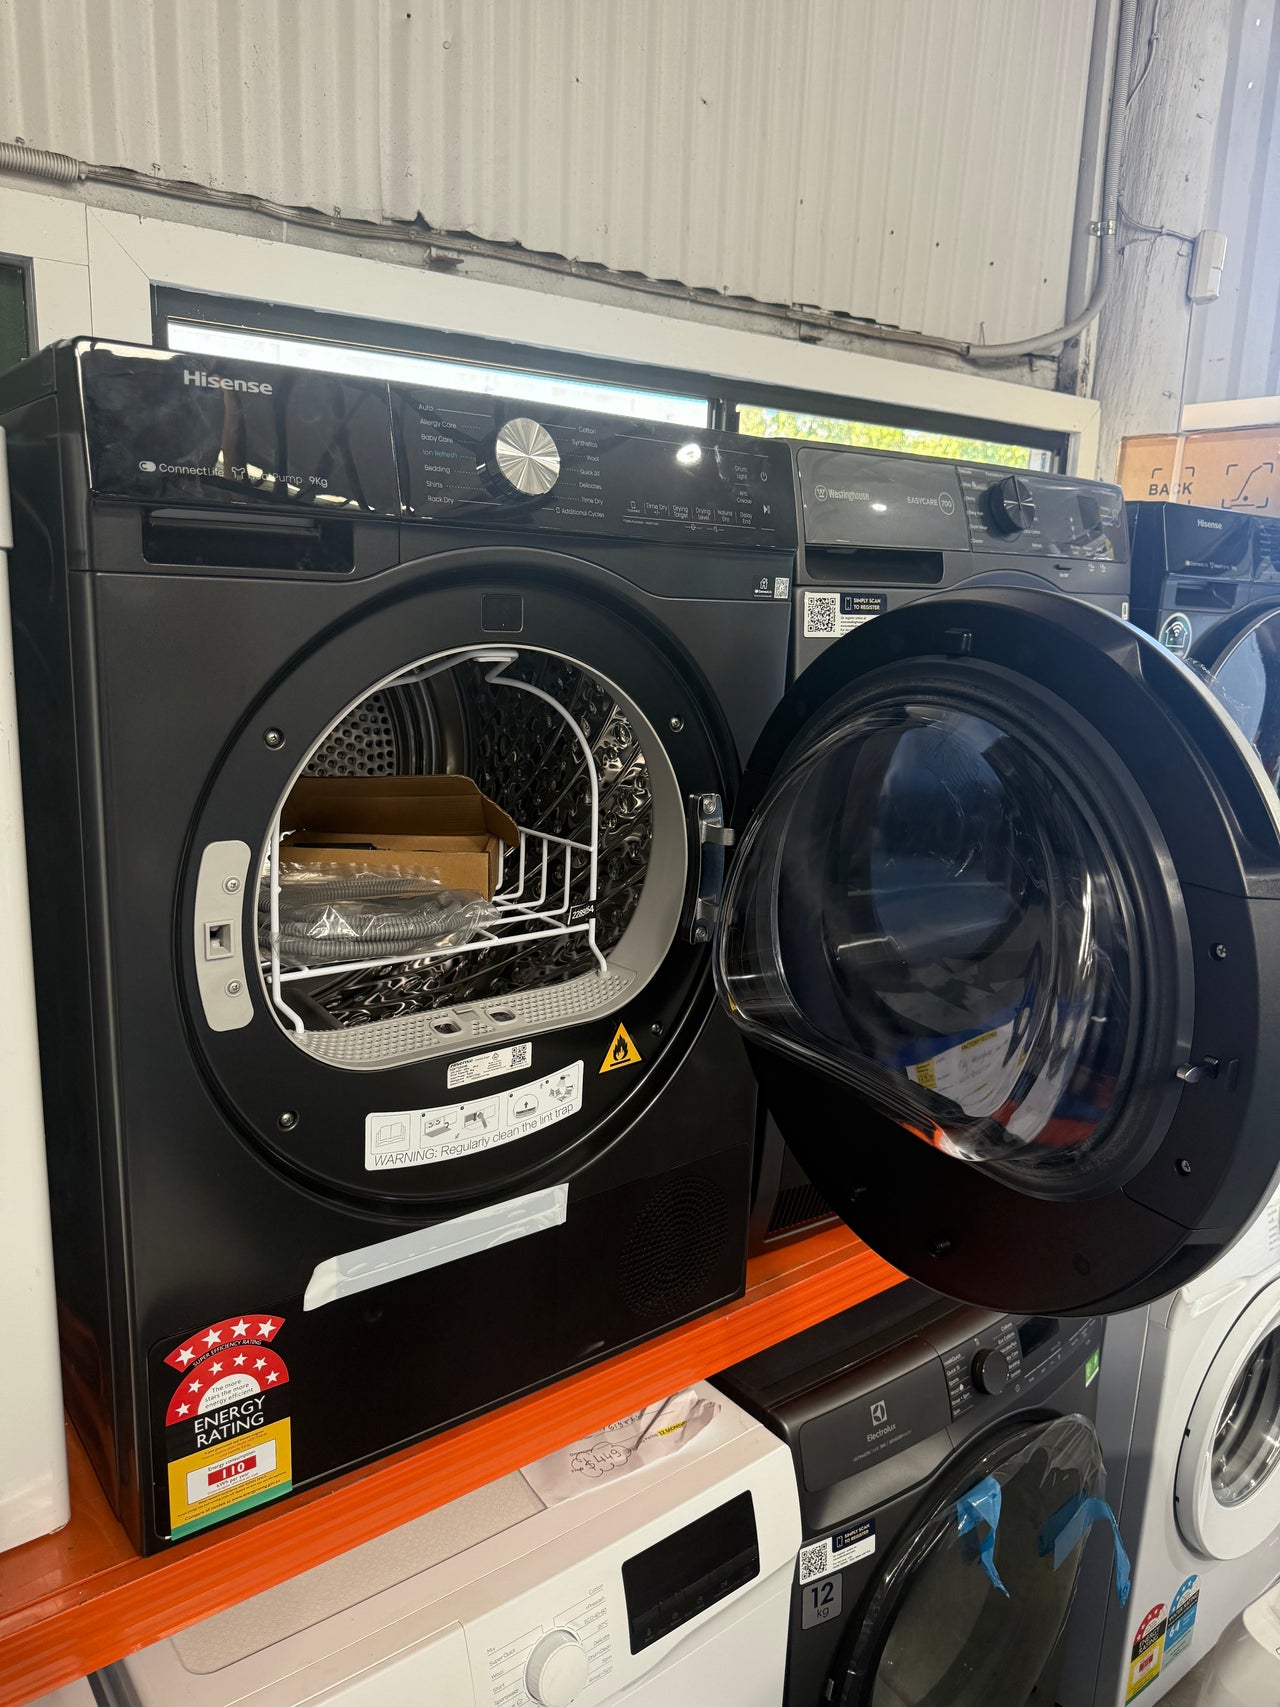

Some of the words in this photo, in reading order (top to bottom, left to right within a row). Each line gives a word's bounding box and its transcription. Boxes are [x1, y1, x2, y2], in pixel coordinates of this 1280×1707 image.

[183, 369, 273, 395] Hisense
[418, 403, 434, 412] Auto
[420, 418, 441, 429] Allergy
[441, 421, 457, 429] Care
[578, 425, 597, 435] Cotton
[421, 433, 438, 443] Baby
[438, 435, 454, 444] Care
[571, 438, 598, 449] Synthetics
[434, 449, 458, 459] Refresh
[158, 463, 225, 478] ConnectLife
[424, 464, 451, 475] Bedding
[308, 476, 328, 488] 9Kg
[425, 480, 443, 489] Shirts
[578, 481, 602, 490] Delicates
[827, 488, 870, 501] Westinghouse
[1148, 481, 1194, 496] BACK
[427, 495, 442, 503] Rack
[443, 496, 454, 505] Dry
[907, 496, 938, 507] EASYCARE
[645, 502, 660, 511] Time
[672, 504, 689, 513] Drying
[695, 507, 712, 516] Drying
[1197, 519, 1223, 530] Hisense
[373, 1148, 438, 1167] WARNING:
[440, 1137, 490, 1157] Regularly
[492, 1126, 520, 1143] clean
[521, 1118, 538, 1133] the
[539, 1112, 553, 1126] lint
[554, 1103, 574, 1121] trap
[192, 1352, 211, 1367] SUPER
[210, 1340, 242, 1355] EFFICIENCY
[204, 1393, 220, 1403] stars
[221, 1387, 232, 1397] the
[233, 1382, 250, 1392] more
[211, 1382, 224, 1394] The
[224, 1379, 242, 1389] more
[205, 1398, 227, 1410] energy
[228, 1387, 254, 1401] efficient
[194, 1395, 266, 1433] ENERGY
[197, 1412, 264, 1448] RATING
[866, 1423, 897, 1443] Electrolux
[207, 1463, 224, 1472] Energy
[225, 1450, 256, 1466] consumption
[222, 1462, 245, 1479] 110
[229, 1477, 238, 1485] per
[240, 1471, 250, 1480] year
[811, 1581, 834, 1609] 12
[816, 1607, 830, 1619] kg
